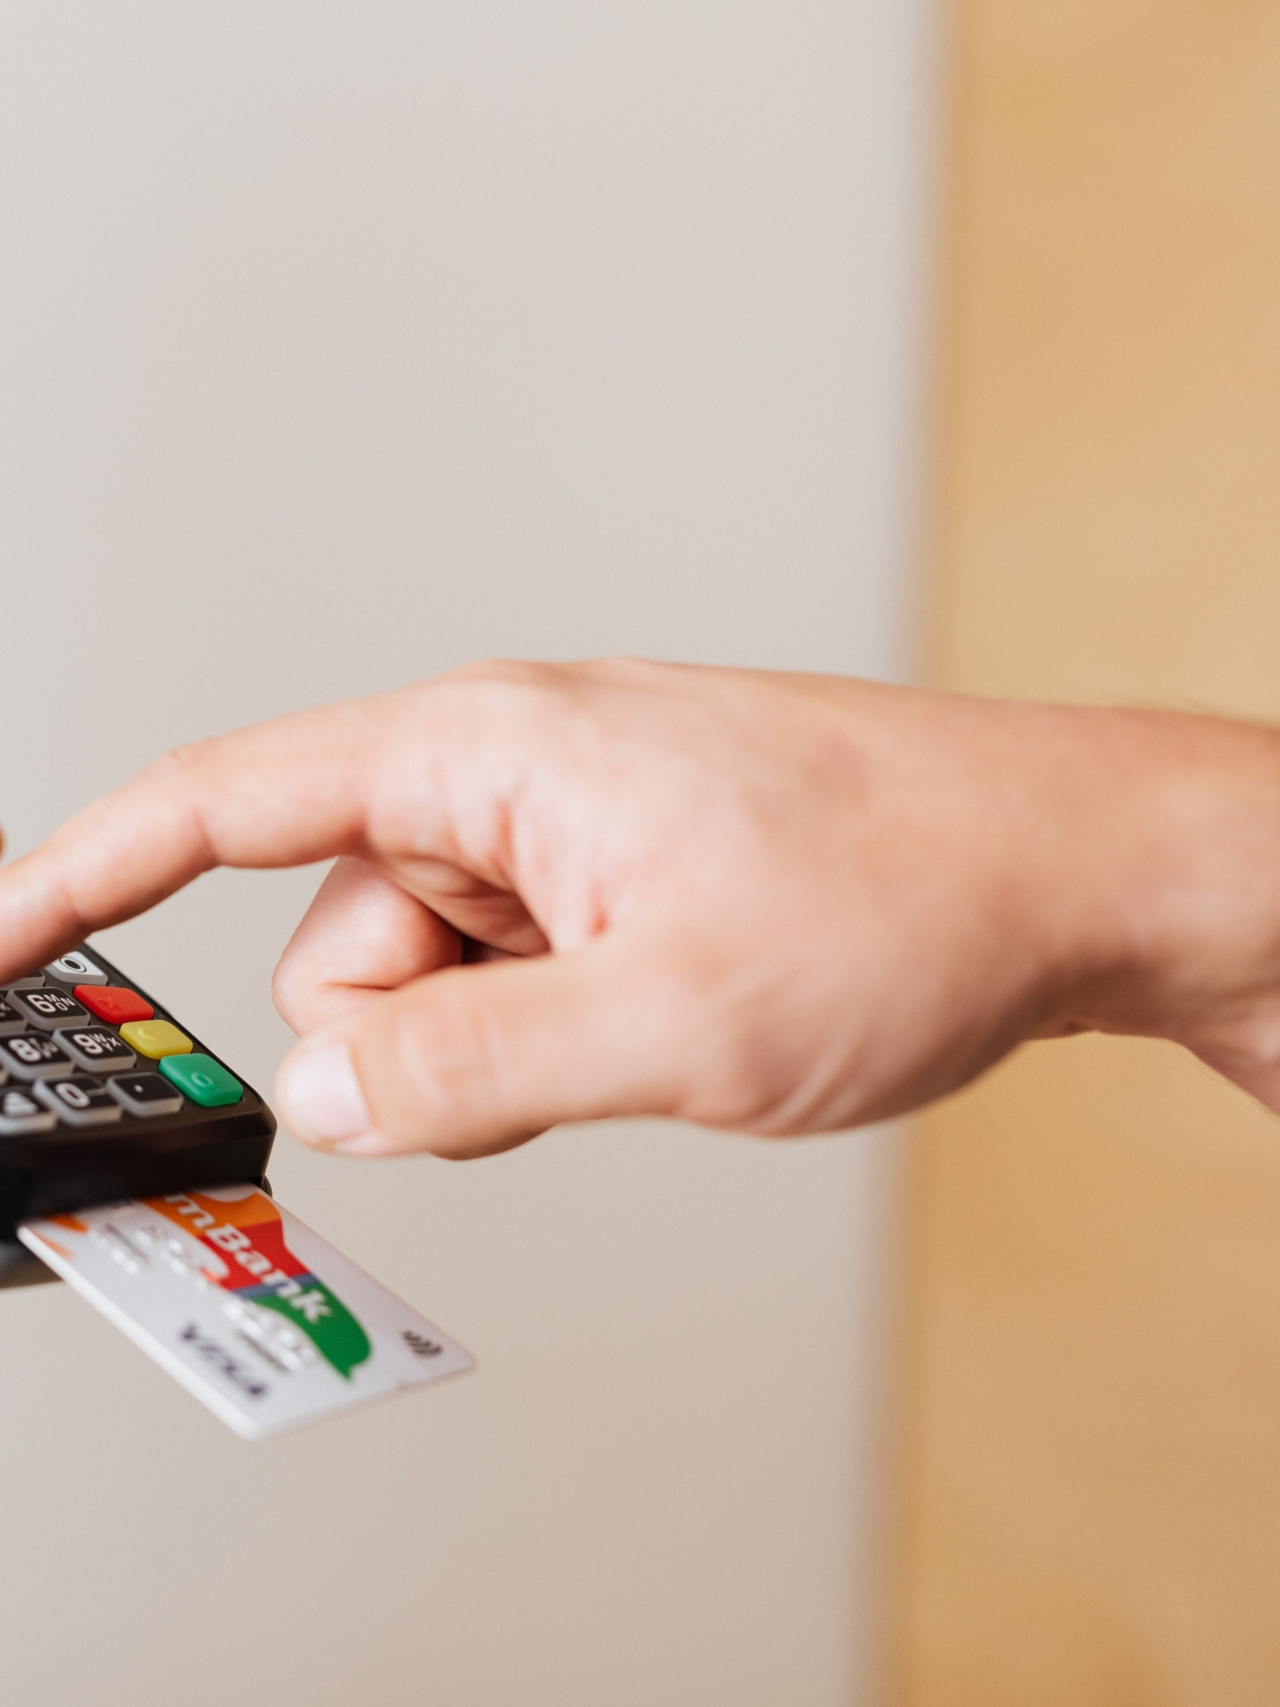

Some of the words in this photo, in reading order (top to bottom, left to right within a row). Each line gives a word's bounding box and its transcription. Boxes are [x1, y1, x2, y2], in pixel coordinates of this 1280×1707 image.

[26, 994, 56, 1013] 6
[8, 1038, 42, 1062] 8
[72, 1034, 104, 1055] 9
[164, 1192, 333, 1325] mBank
